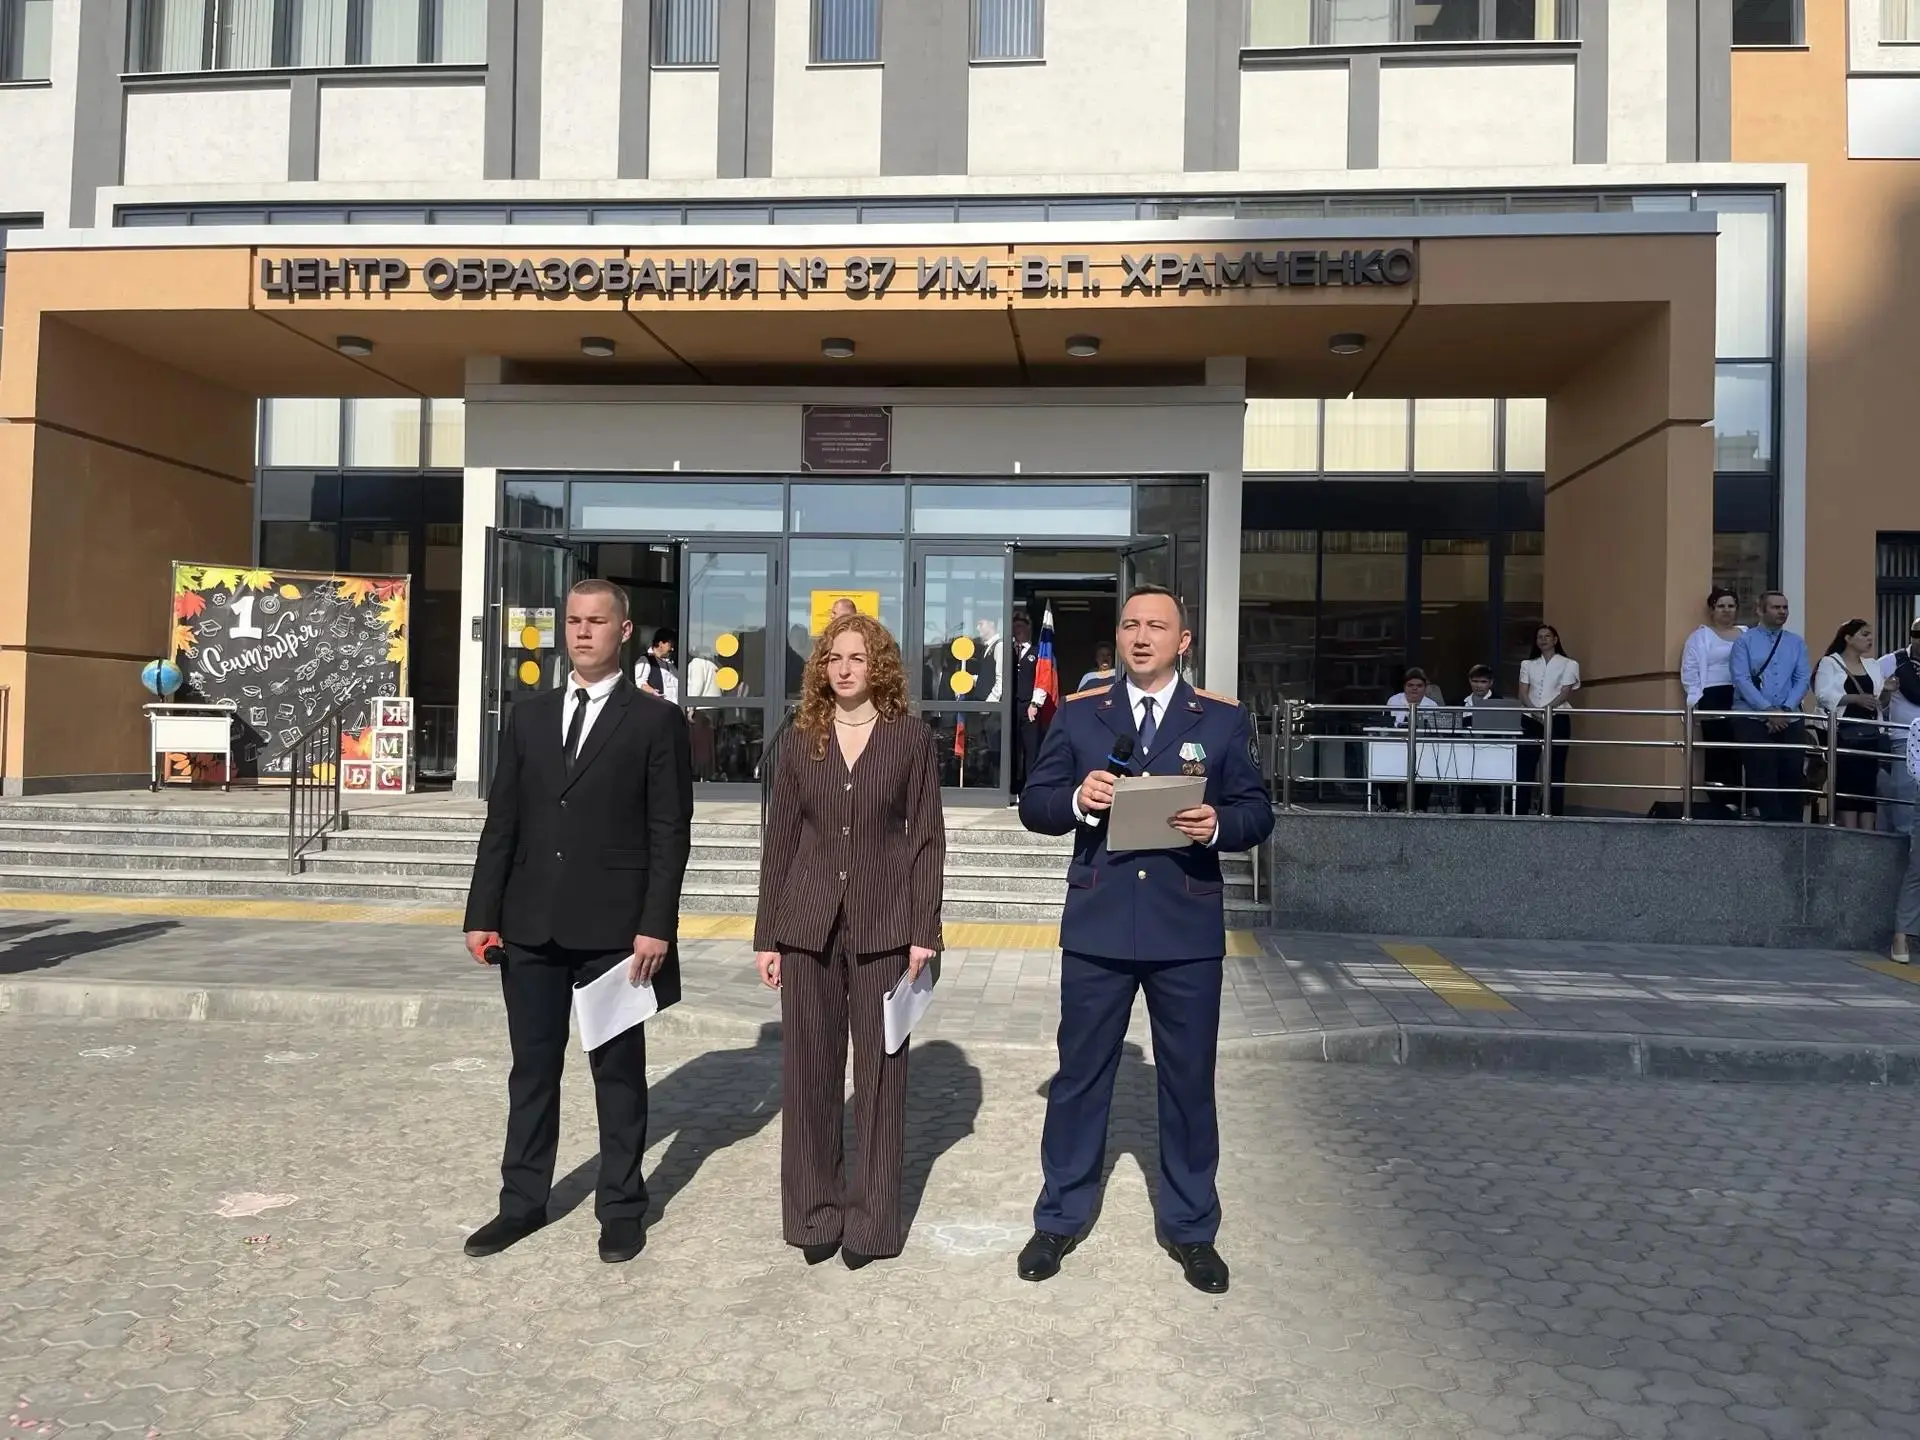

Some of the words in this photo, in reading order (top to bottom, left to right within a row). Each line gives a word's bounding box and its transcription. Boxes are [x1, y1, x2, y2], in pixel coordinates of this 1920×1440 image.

[261, 258, 408, 295] ЦЕНТР
[423, 257, 759, 292] ОБРАЗОВАНИЯ
[778, 256, 828, 291] №
[845, 255, 896, 291] 37
[917, 256, 997, 292] ИМ.
[1021, 254, 1101, 291] В.П.
[1121, 247, 1416, 290] ХРАМЧЕНКО
[229, 596, 262, 639] 1
